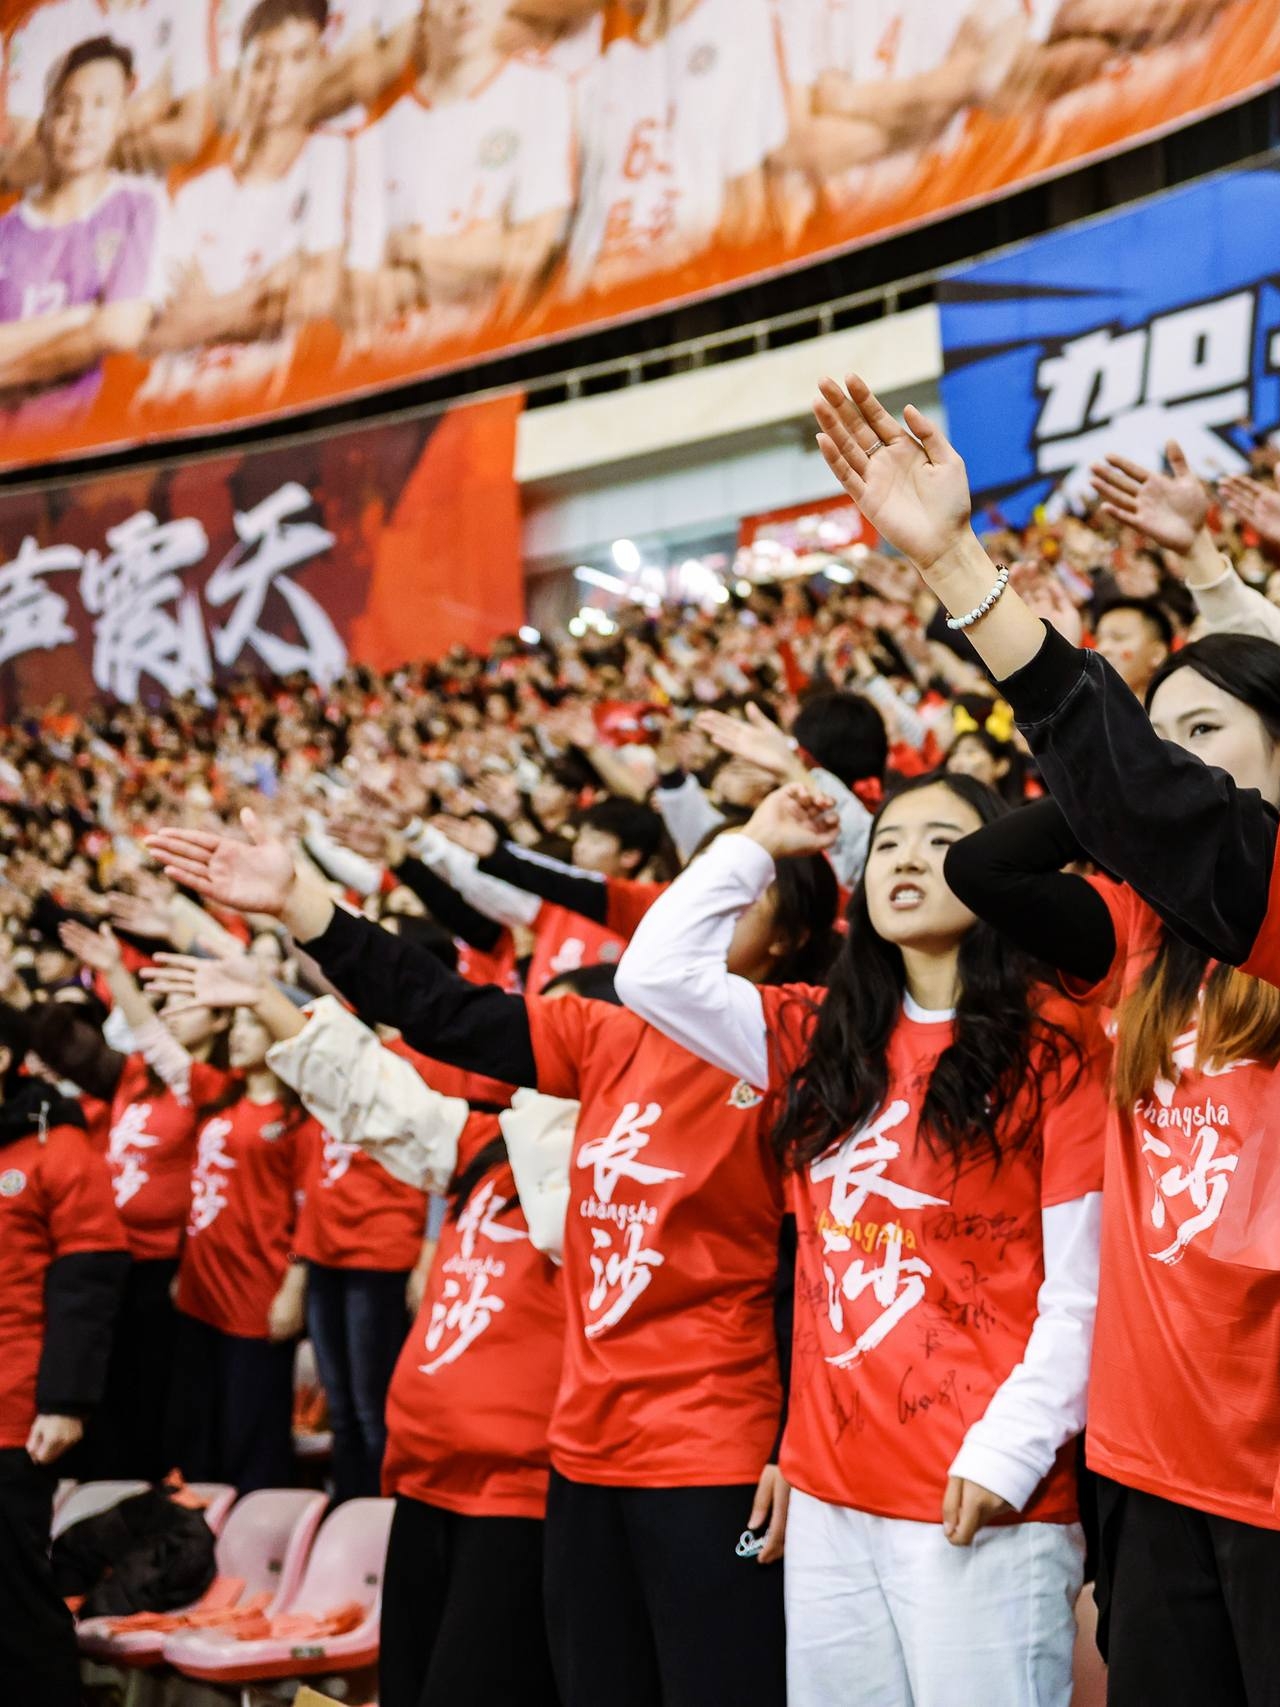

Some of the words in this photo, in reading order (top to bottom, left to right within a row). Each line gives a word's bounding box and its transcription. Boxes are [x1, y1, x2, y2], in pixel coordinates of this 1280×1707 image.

[576, 1102, 687, 1203] 长
[809, 1099, 952, 1228] 长
[1141, 1125, 1240, 1267] 沙
[579, 1195, 659, 1231] changsha
[817, 1210, 917, 1255] hangsha
[417, 1272, 505, 1375] 沙
[583, 1221, 665, 1339] 沙
[822, 1222, 933, 1369] 沙
